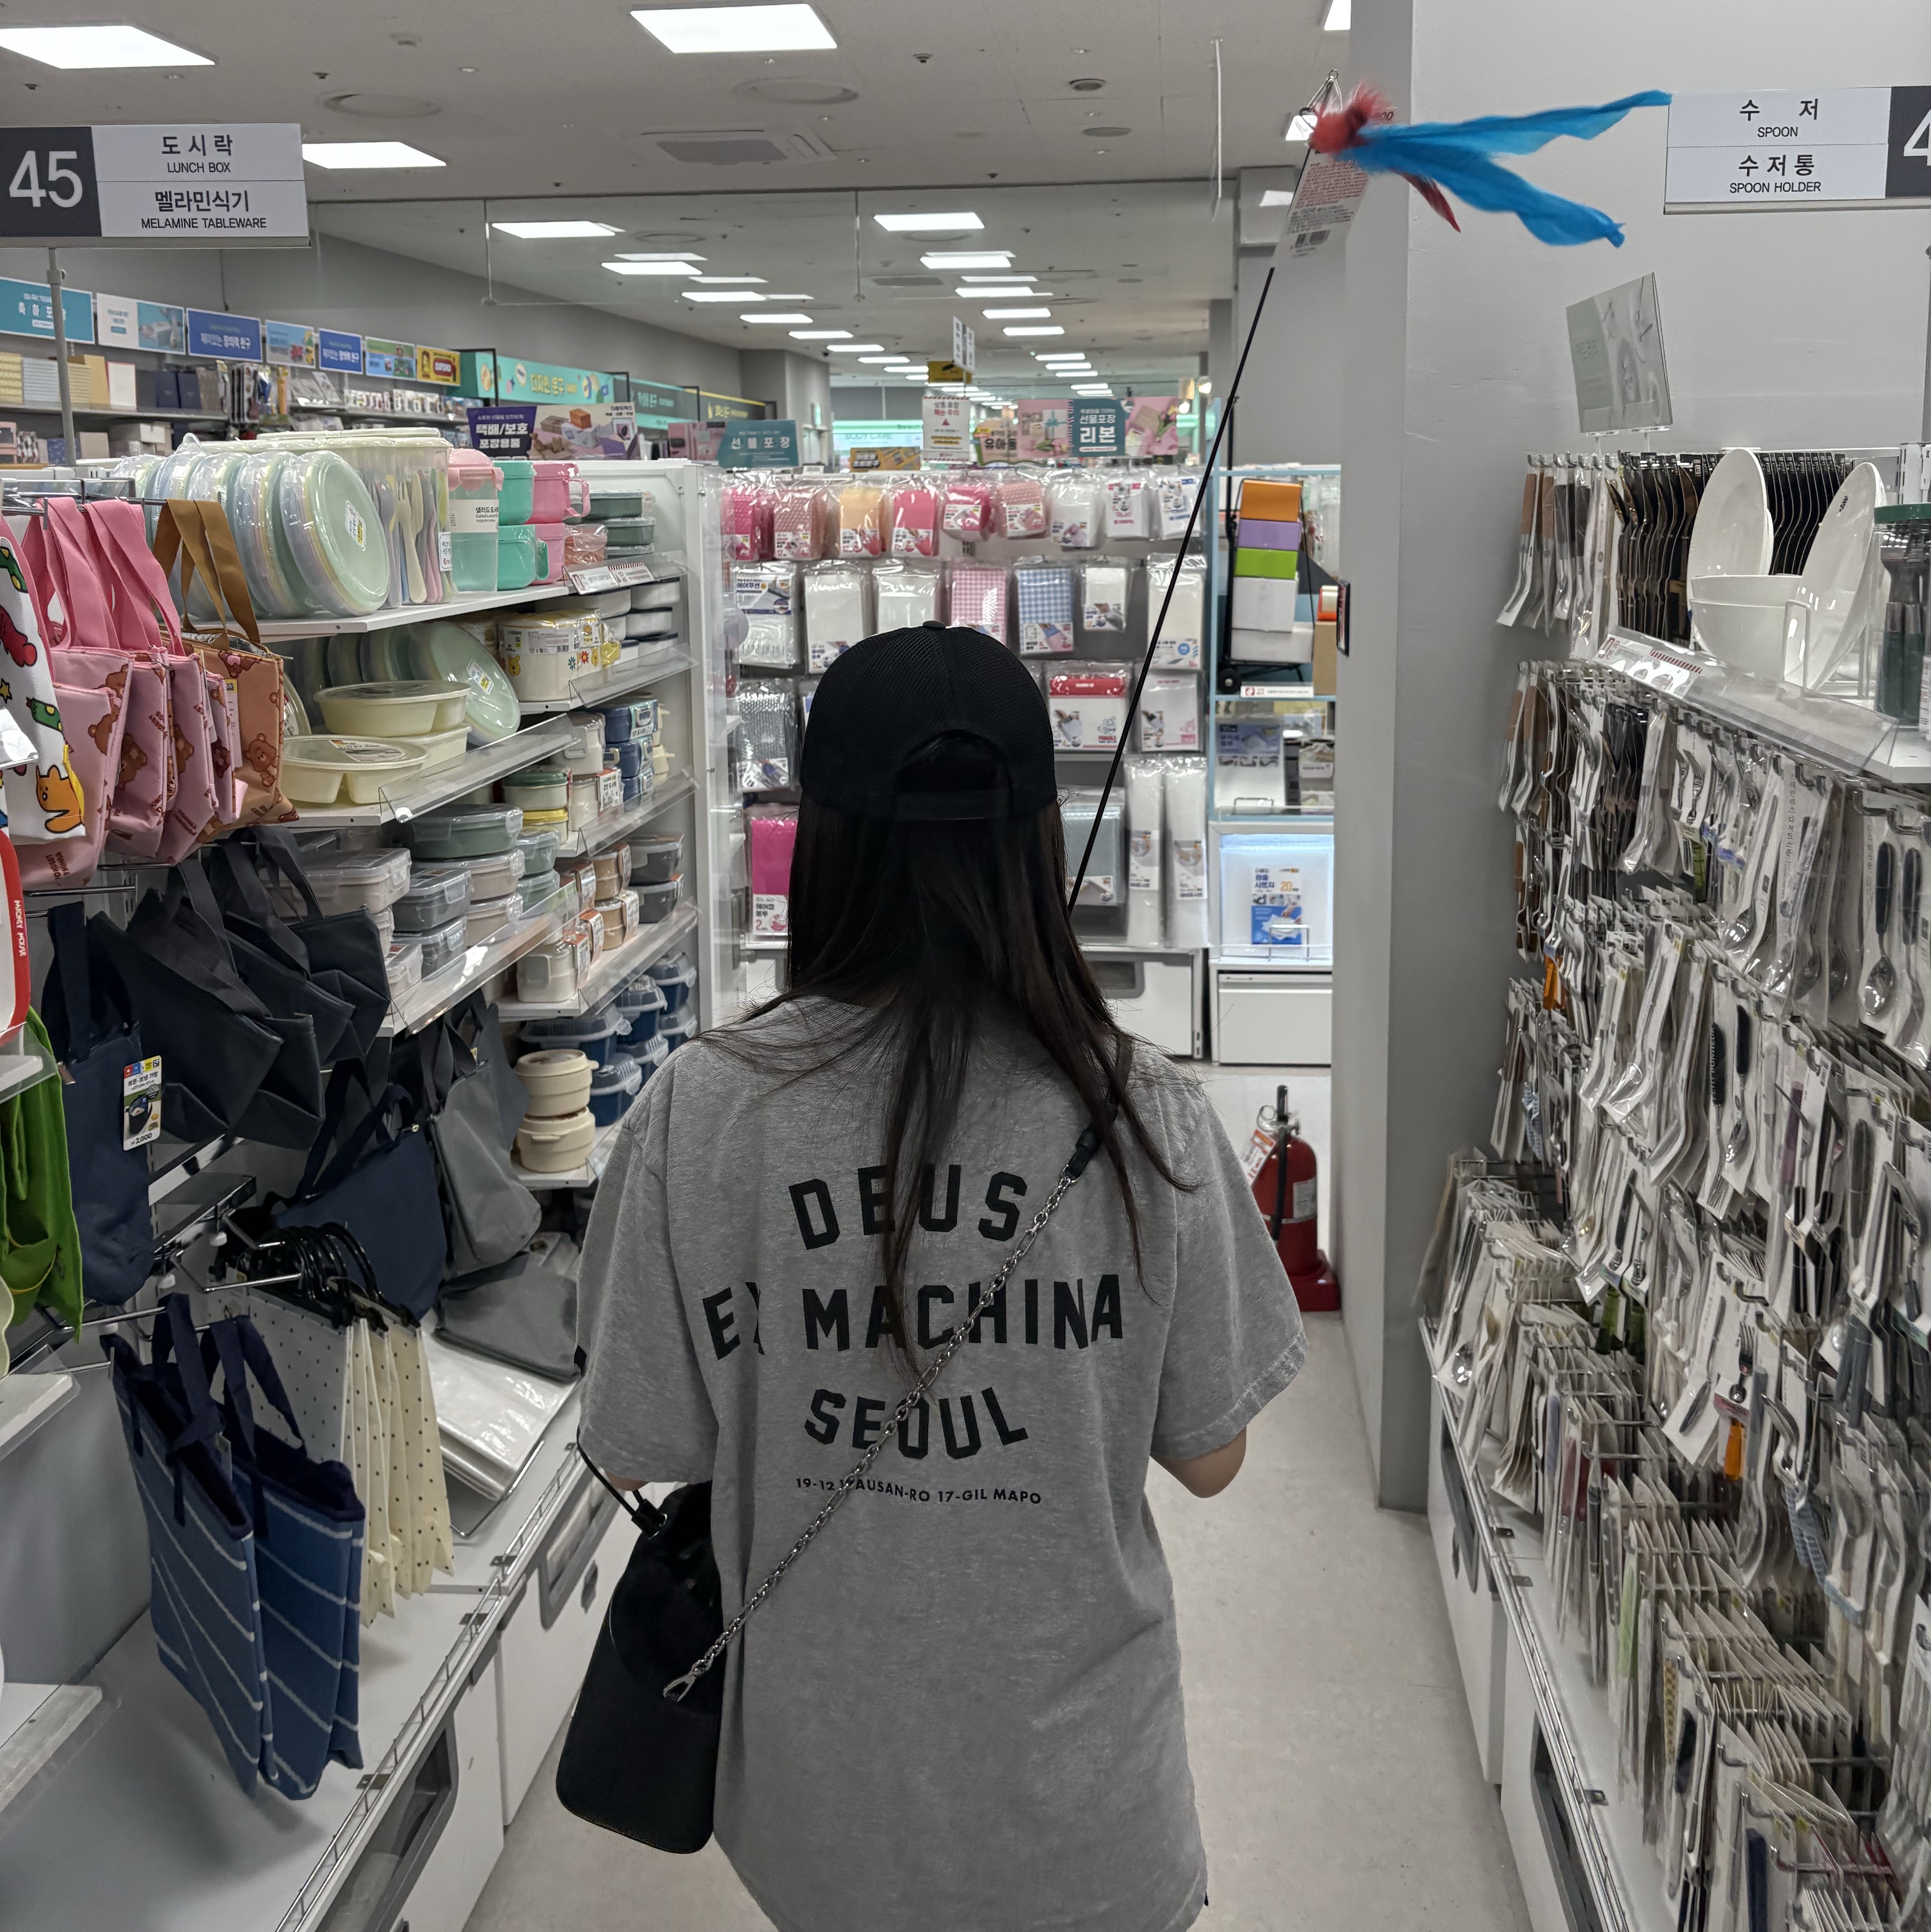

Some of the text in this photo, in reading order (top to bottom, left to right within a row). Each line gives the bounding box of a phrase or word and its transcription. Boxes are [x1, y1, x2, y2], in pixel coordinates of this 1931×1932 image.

[1757, 126, 1798, 138] SPOON
[167, 162, 231, 173] LUNCH BOX
[1738, 154, 1814, 177] 수저통
[9, 151, 83, 208] 45
[1729, 181, 1821, 194] SPOON HOLDER
[155, 190, 249, 213] 멜라민식기
[141, 218, 267, 229] MELAMINE TABLEWARE
[476, 423, 528, 436] 택배/보호
[1080, 427, 1115, 443] 리본
[479, 438, 520, 449] 포장용품
[788, 1163, 1027, 1250] DEUS
[802, 1274, 1123, 1352] MACHINA
[804, 1387, 1028, 1460] SEOUL
[796, 1478, 834, 1491] 19-12
[938, 1489, 987, 1502] 17-GIL
[993, 1489, 1041, 1505] MAPO
